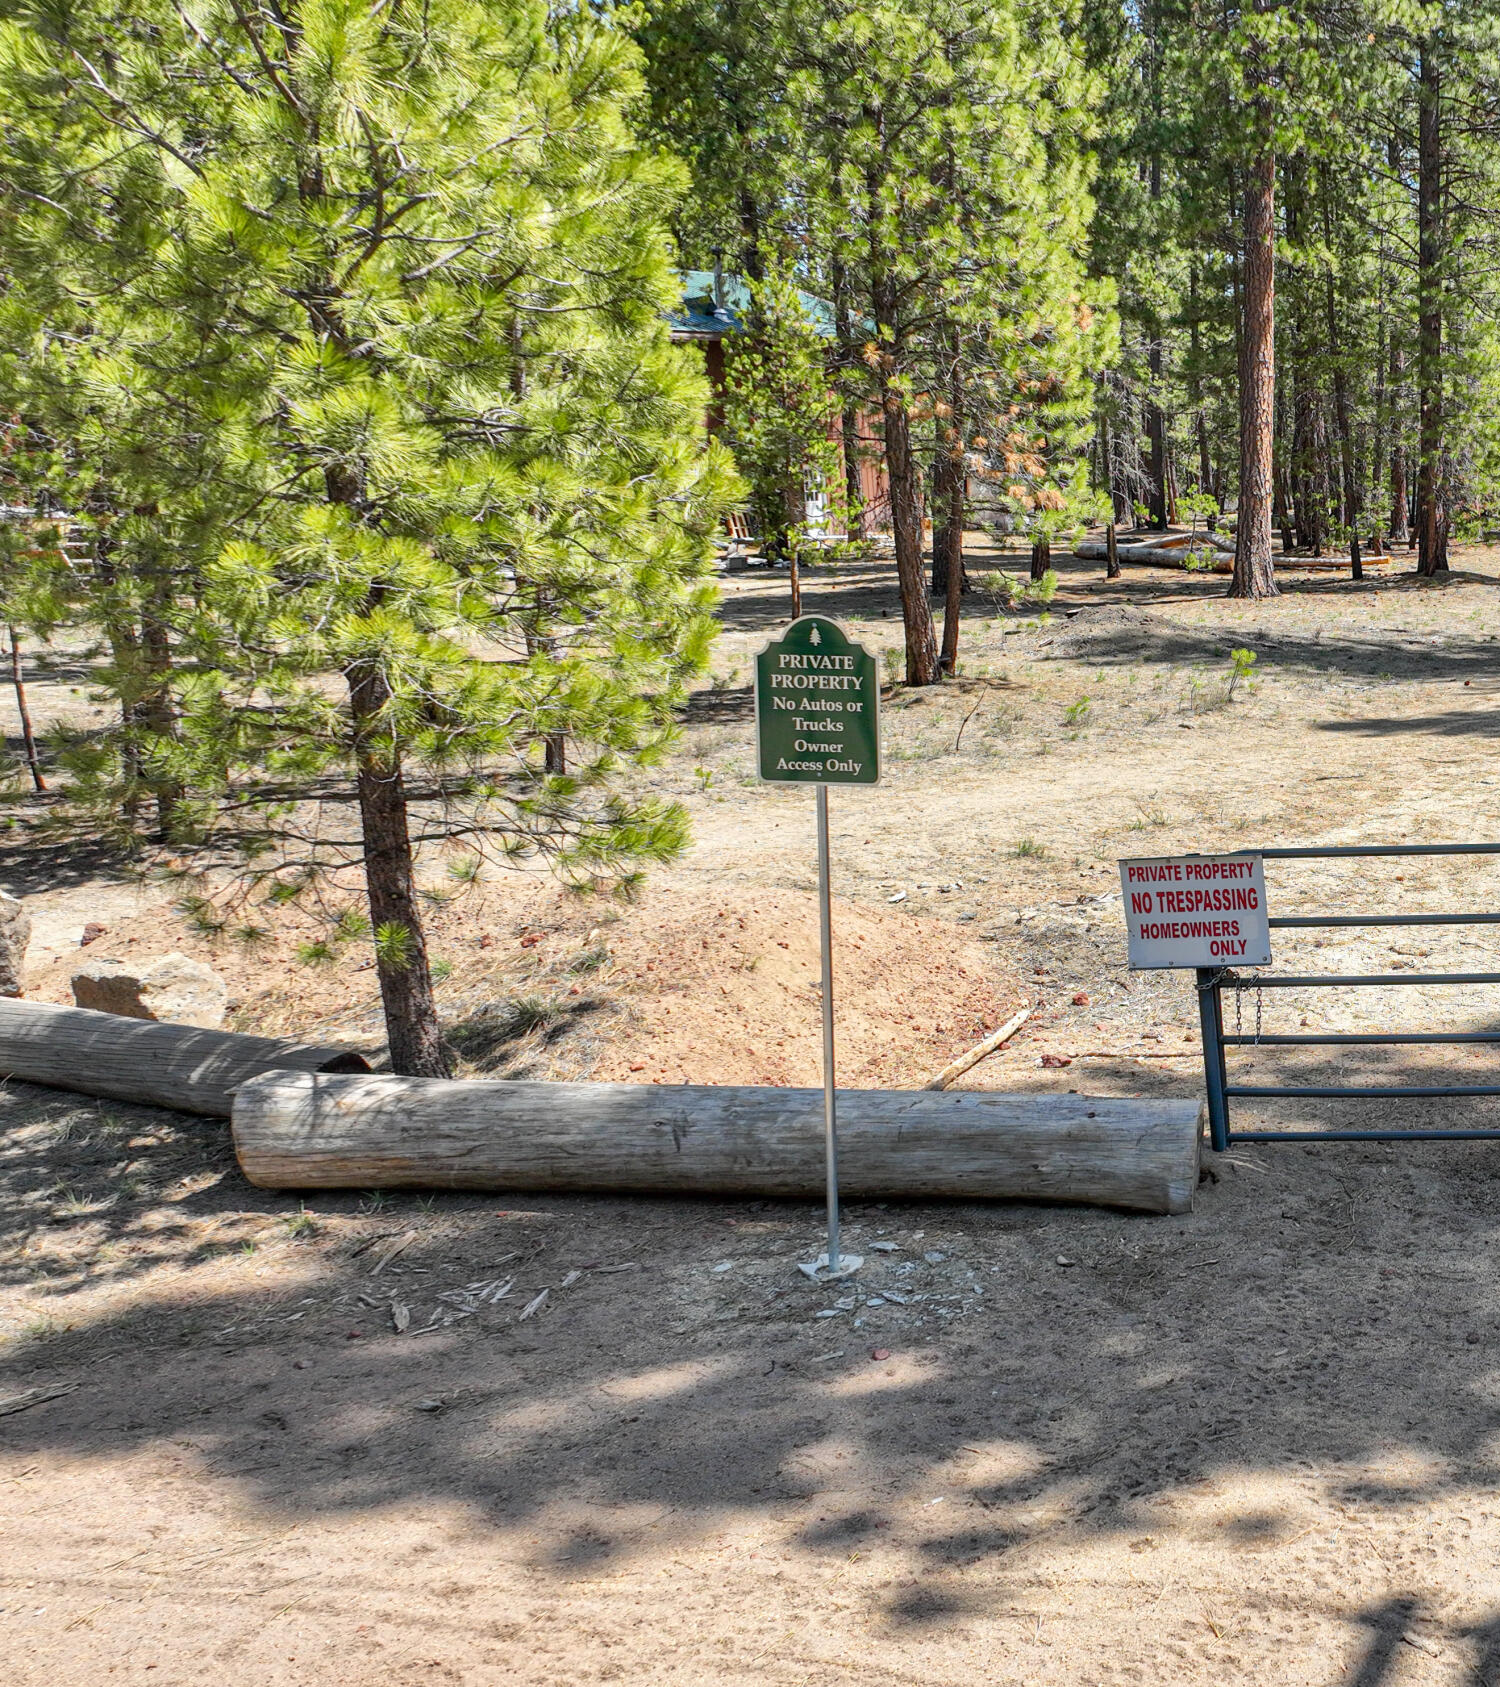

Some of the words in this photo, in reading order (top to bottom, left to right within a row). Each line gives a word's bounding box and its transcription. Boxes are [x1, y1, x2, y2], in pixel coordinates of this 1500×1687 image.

[778, 654, 854, 669] PRIVATE
[770, 674, 863, 690] PROPERTY
[772, 696, 796, 711] No
[800, 697, 843, 712] Autos
[846, 702, 863, 712] or
[792, 717, 844, 732] Trucks
[794, 739, 844, 753] Owner
[776, 757, 823, 771] Access
[826, 759, 862, 775] Only
[1128, 865, 1182, 882] PRIVATE
[1185, 862, 1254, 880] PROPERTY
[1131, 892, 1153, 914] NO
[1156, 887, 1259, 913] TRESPASSING
[1140, 920, 1240, 939] HOMEOWNERS
[1209, 939, 1247, 957] ONLY
